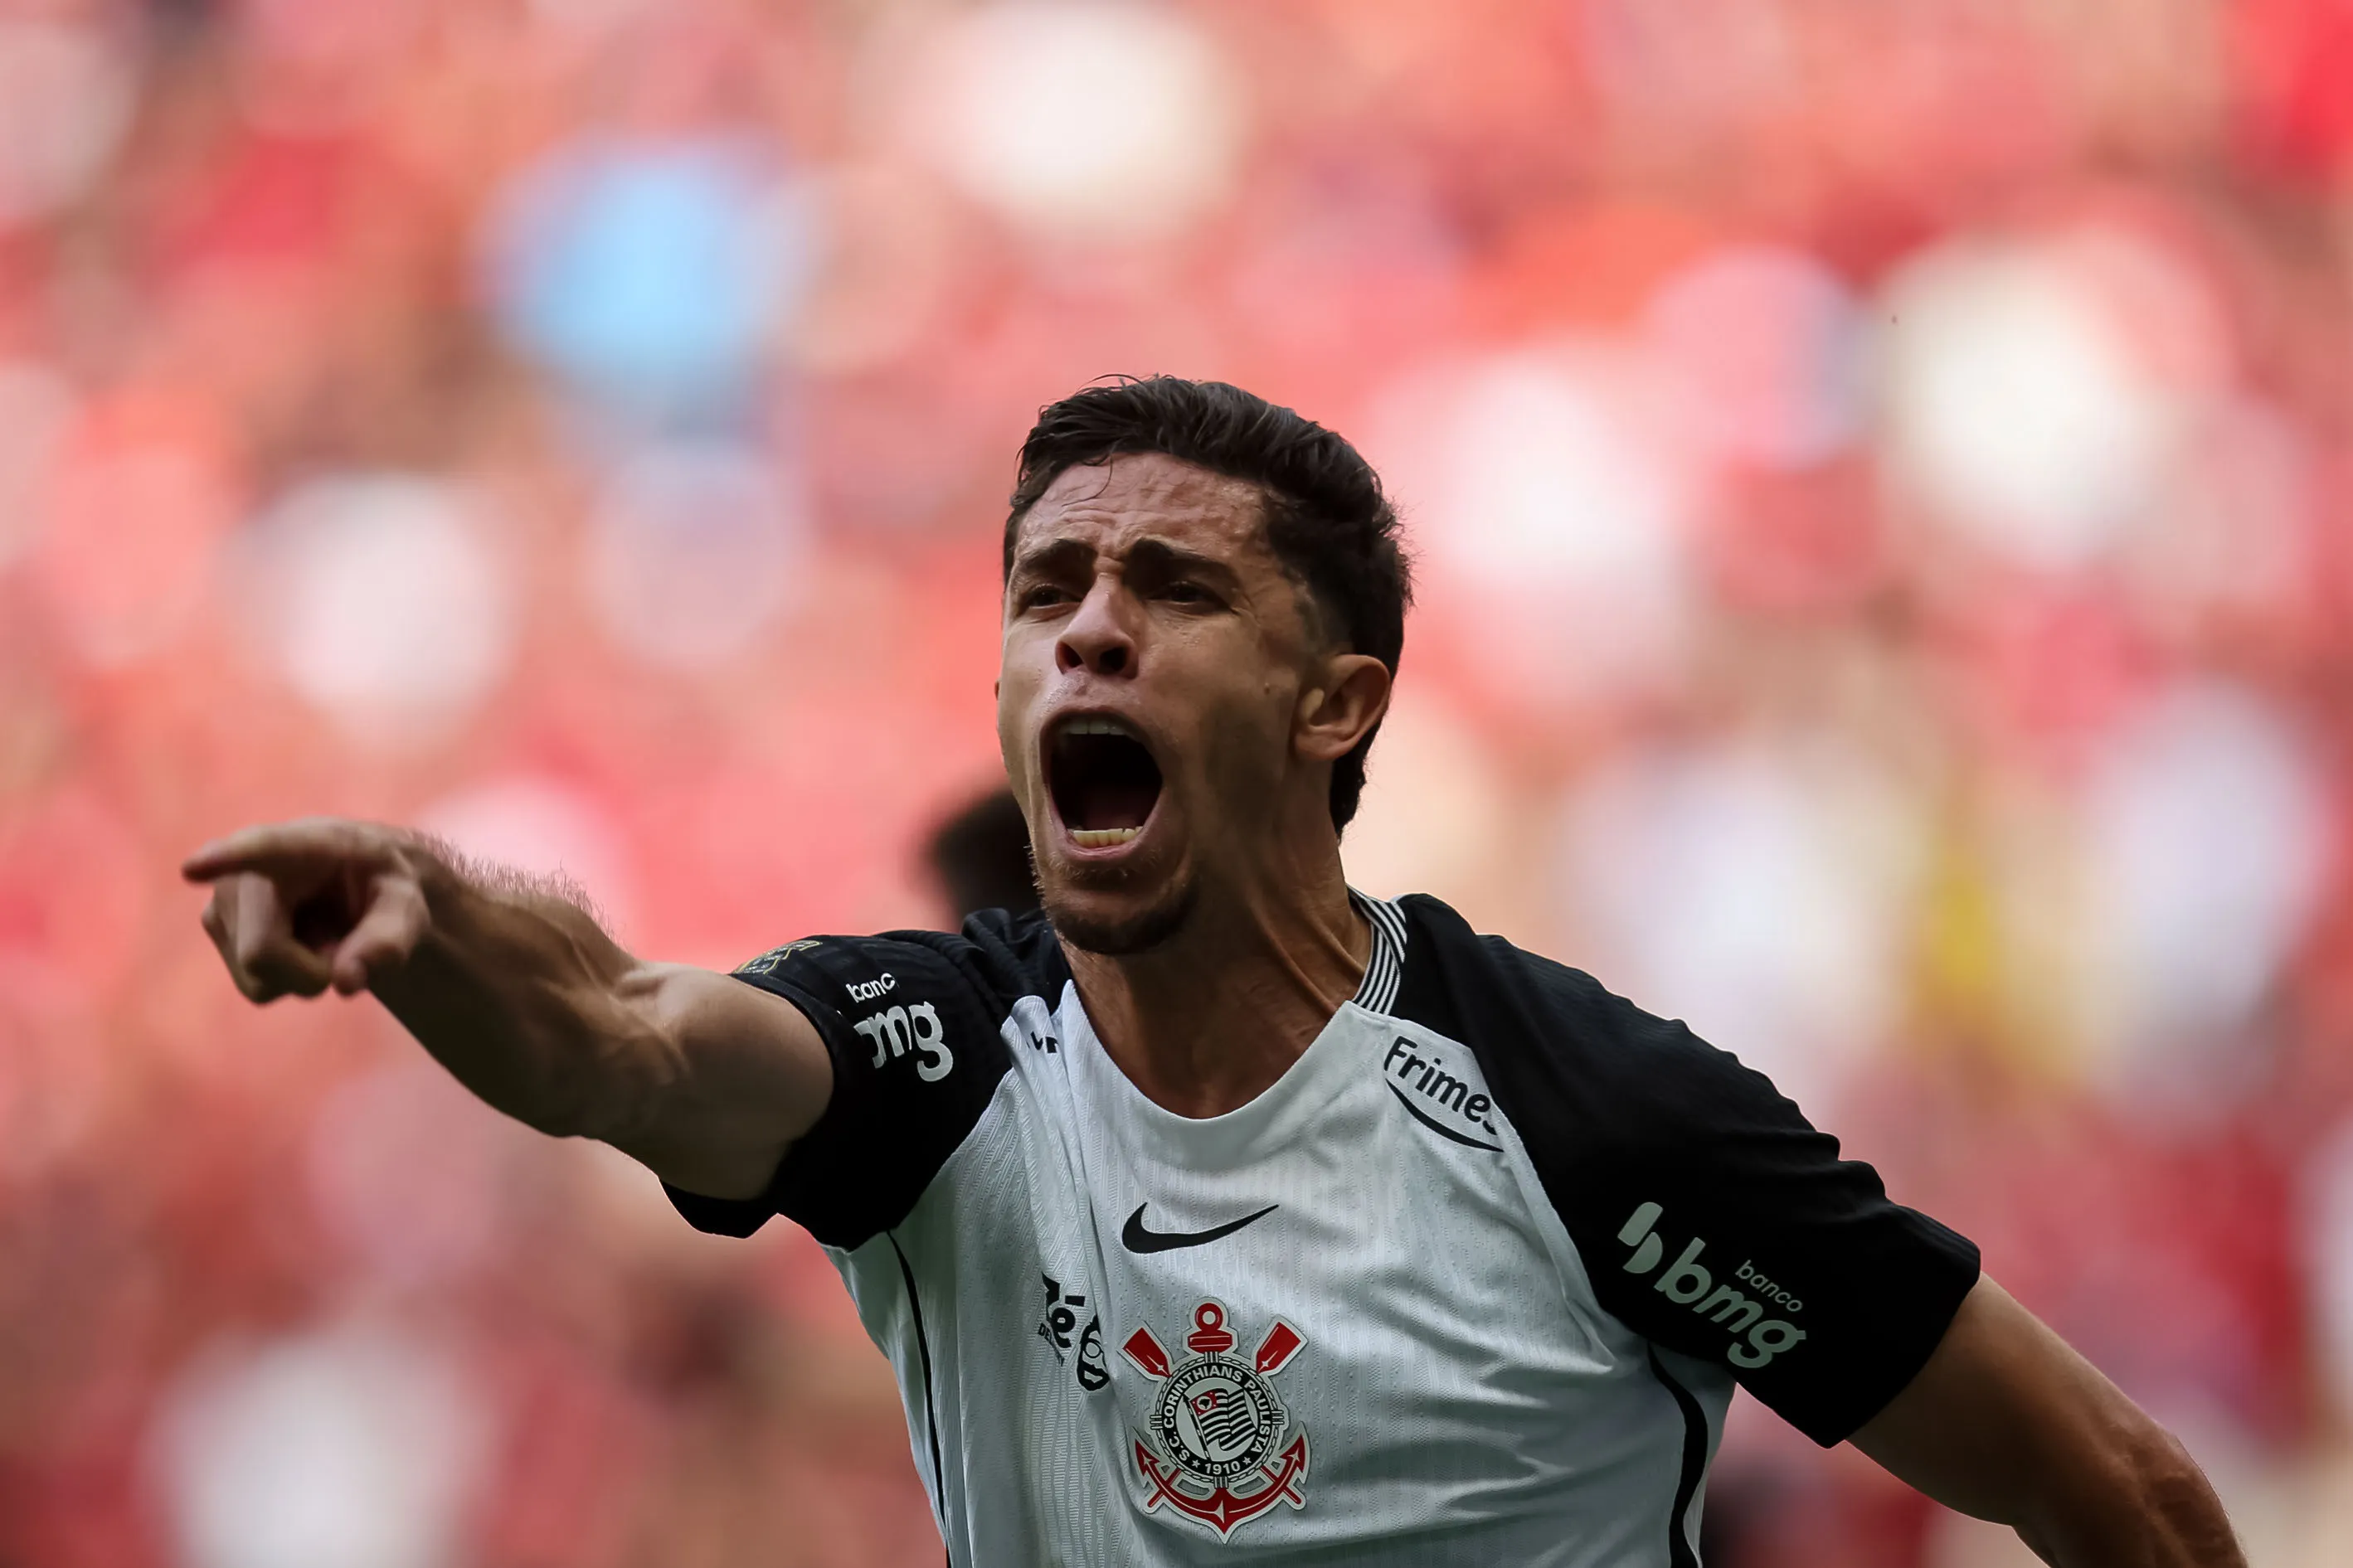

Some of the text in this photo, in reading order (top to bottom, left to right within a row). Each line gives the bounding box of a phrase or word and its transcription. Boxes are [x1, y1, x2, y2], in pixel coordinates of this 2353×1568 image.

[845, 973, 899, 1003] banc
[1653, 1236, 1807, 1368] bmg
[1734, 1259, 1803, 1313] banco
[1163, 1365, 1243, 1429] CORINTHIANS
[1243, 1380, 1271, 1454] PAULISTA
[1204, 1460, 1242, 1475] 1910
